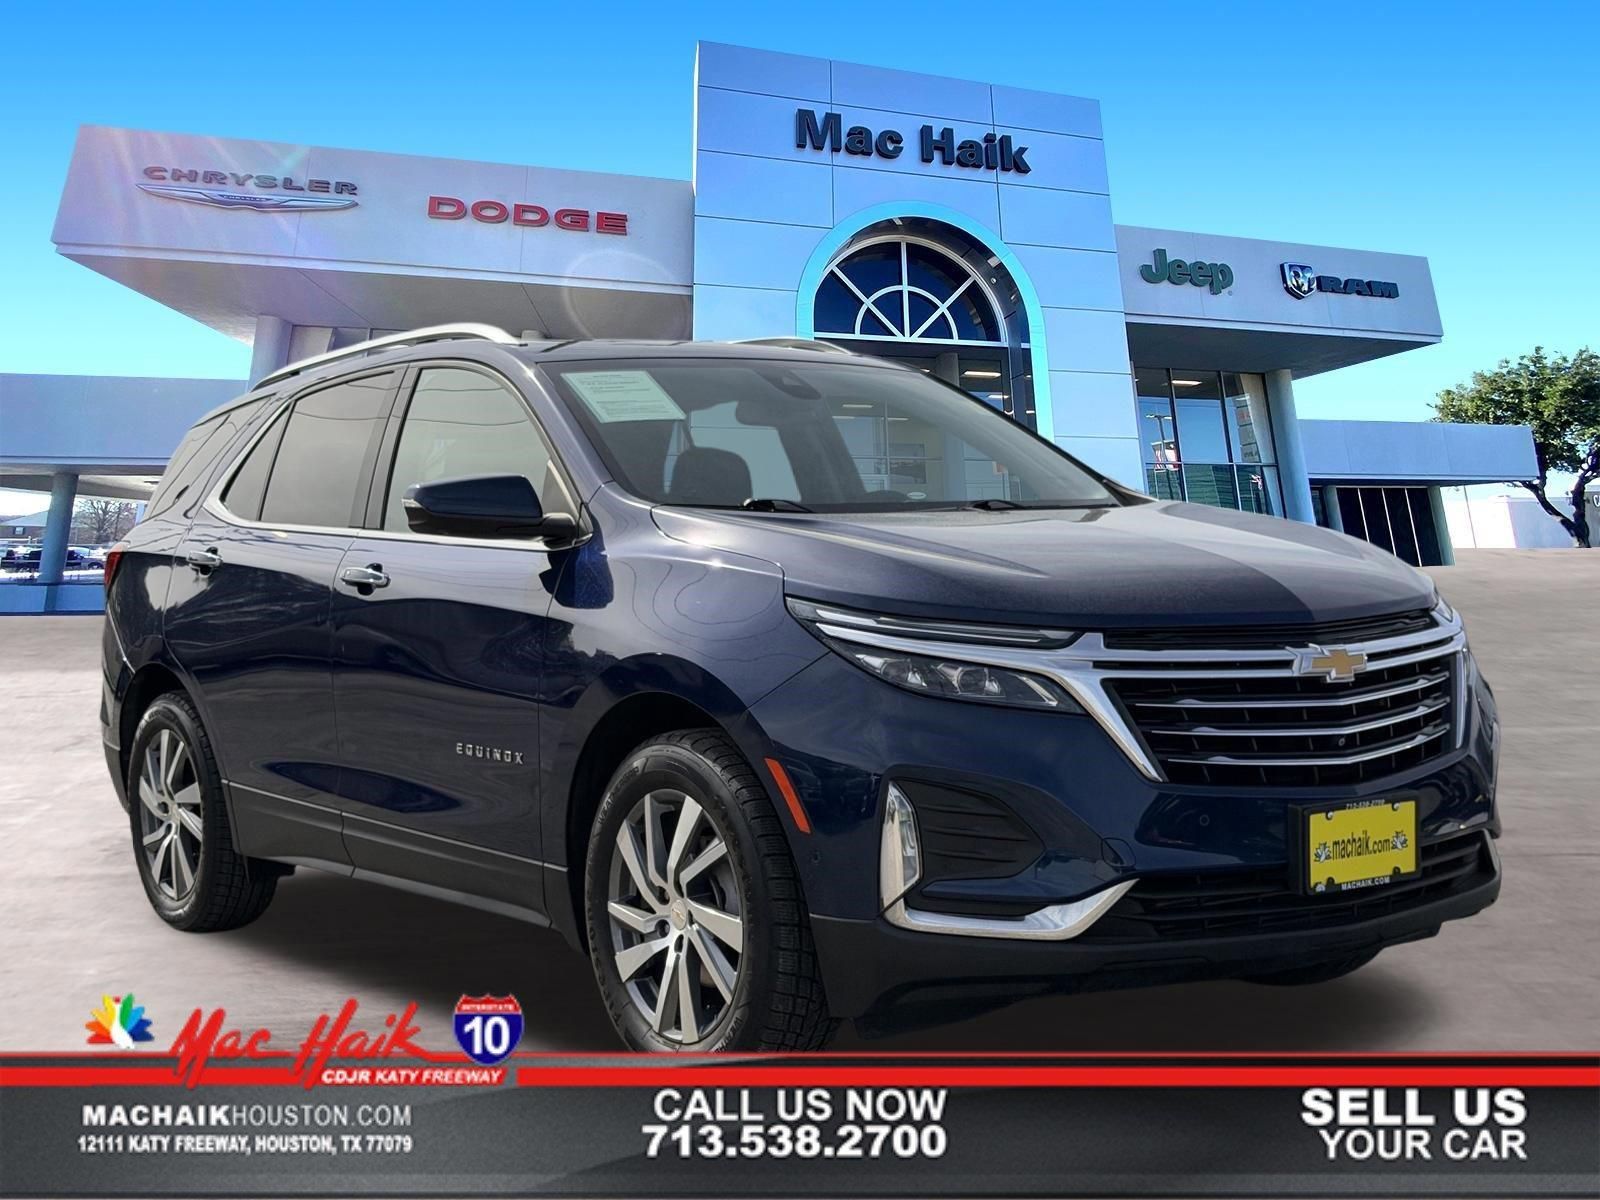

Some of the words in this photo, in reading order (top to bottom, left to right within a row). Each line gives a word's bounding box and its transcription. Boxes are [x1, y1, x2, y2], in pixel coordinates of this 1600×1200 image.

[795, 108, 904, 159] Mac
[920, 124, 1032, 174] Haik
[143, 166, 358, 196] CHRYSLER
[428, 196, 628, 236] DODGE
[1140, 248, 1234, 295] Jeep
[1316, 275, 1399, 299] RAM
[456, 742, 523, 765] EQUINOX
[1332, 830, 1391, 860] machaik.com
[1341, 876, 1391, 891] MACHAIK.COM
